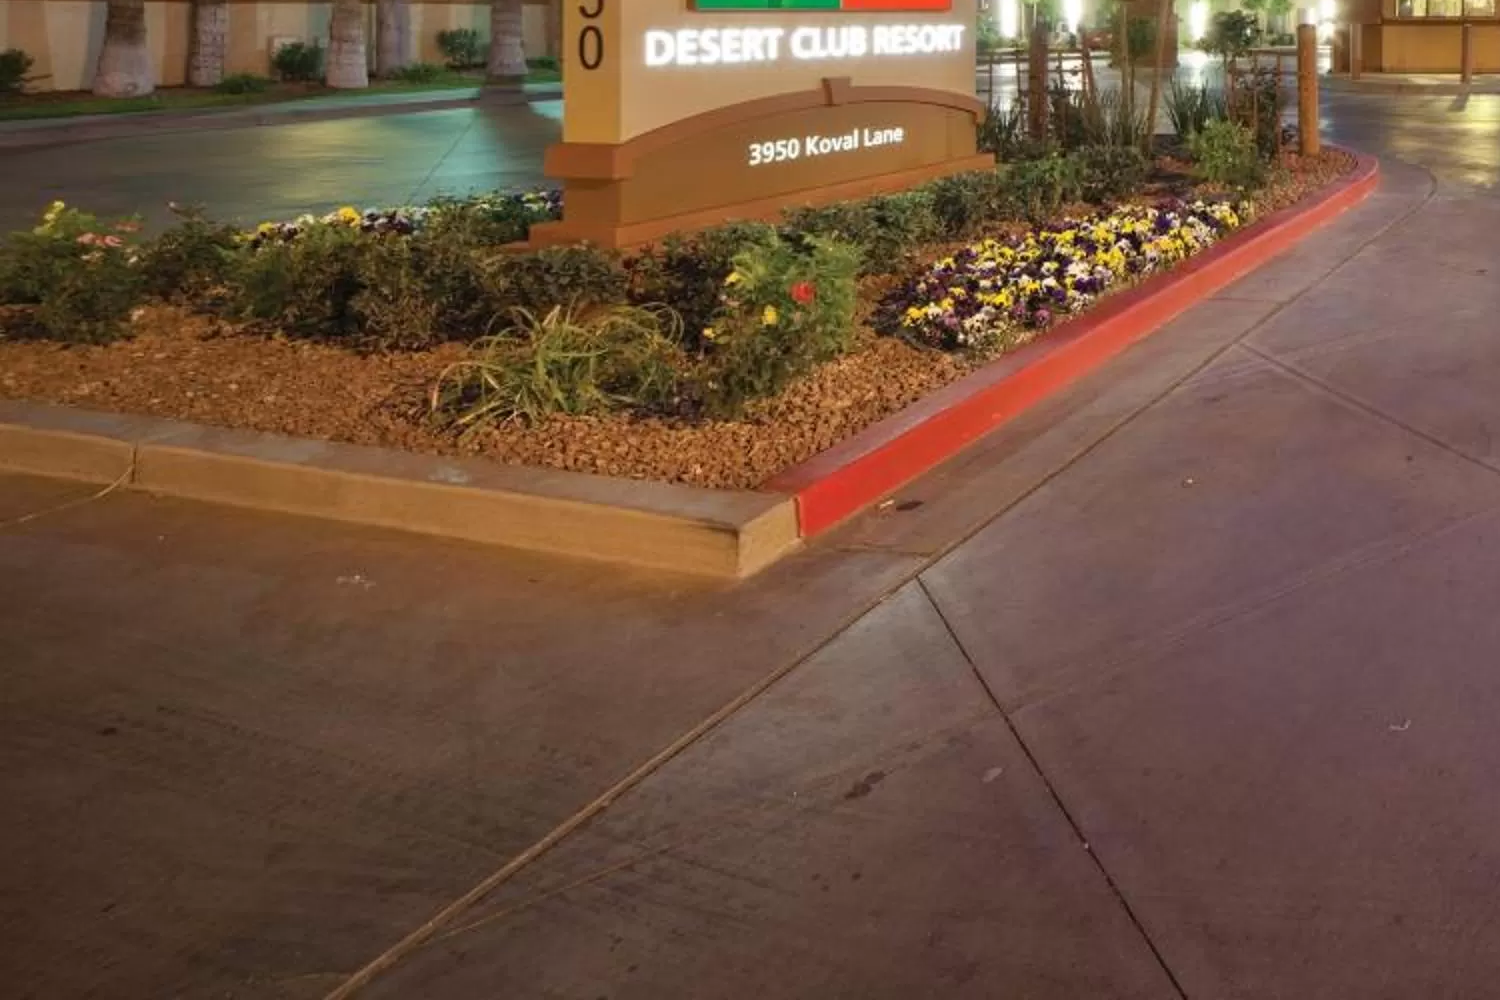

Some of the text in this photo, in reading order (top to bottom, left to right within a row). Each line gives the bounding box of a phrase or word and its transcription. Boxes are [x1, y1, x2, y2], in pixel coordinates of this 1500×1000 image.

[644, 23, 966, 66] DESERT CLUB RESORT
[749, 126, 904, 166] 3950 Koval Lane
